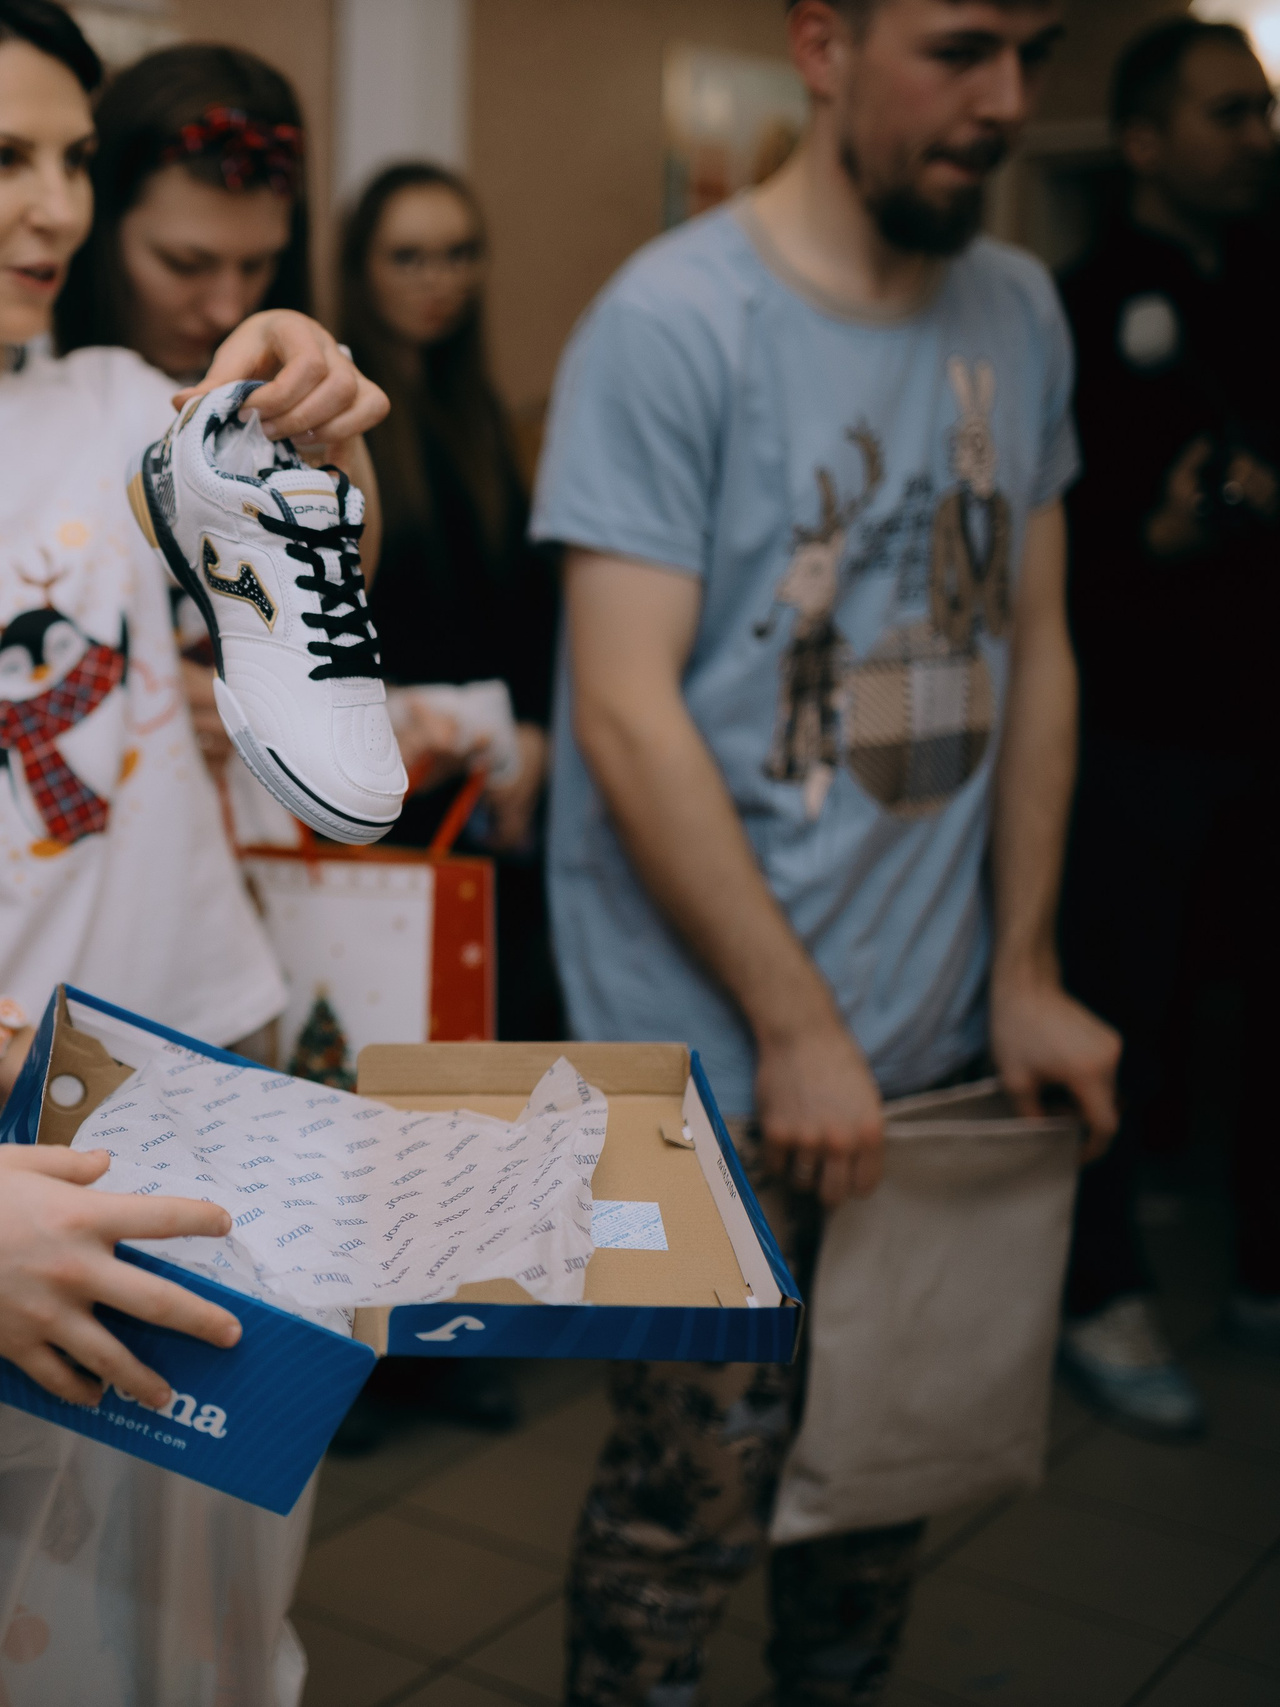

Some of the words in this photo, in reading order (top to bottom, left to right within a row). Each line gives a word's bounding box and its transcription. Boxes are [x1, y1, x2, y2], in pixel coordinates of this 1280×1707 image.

[298, 1118, 334, 1138] Joma
[139, 1131, 177, 1152] Joma
[395, 1140, 431, 1161] Joma
[287, 1172, 323, 1186] Joma
[336, 1193, 371, 1206] Joma
[385, 1190, 422, 1210] Joma
[437, 1186, 474, 1208] Joma
[275, 1223, 313, 1248] Joma
[312, 1272, 353, 1285] Joma
